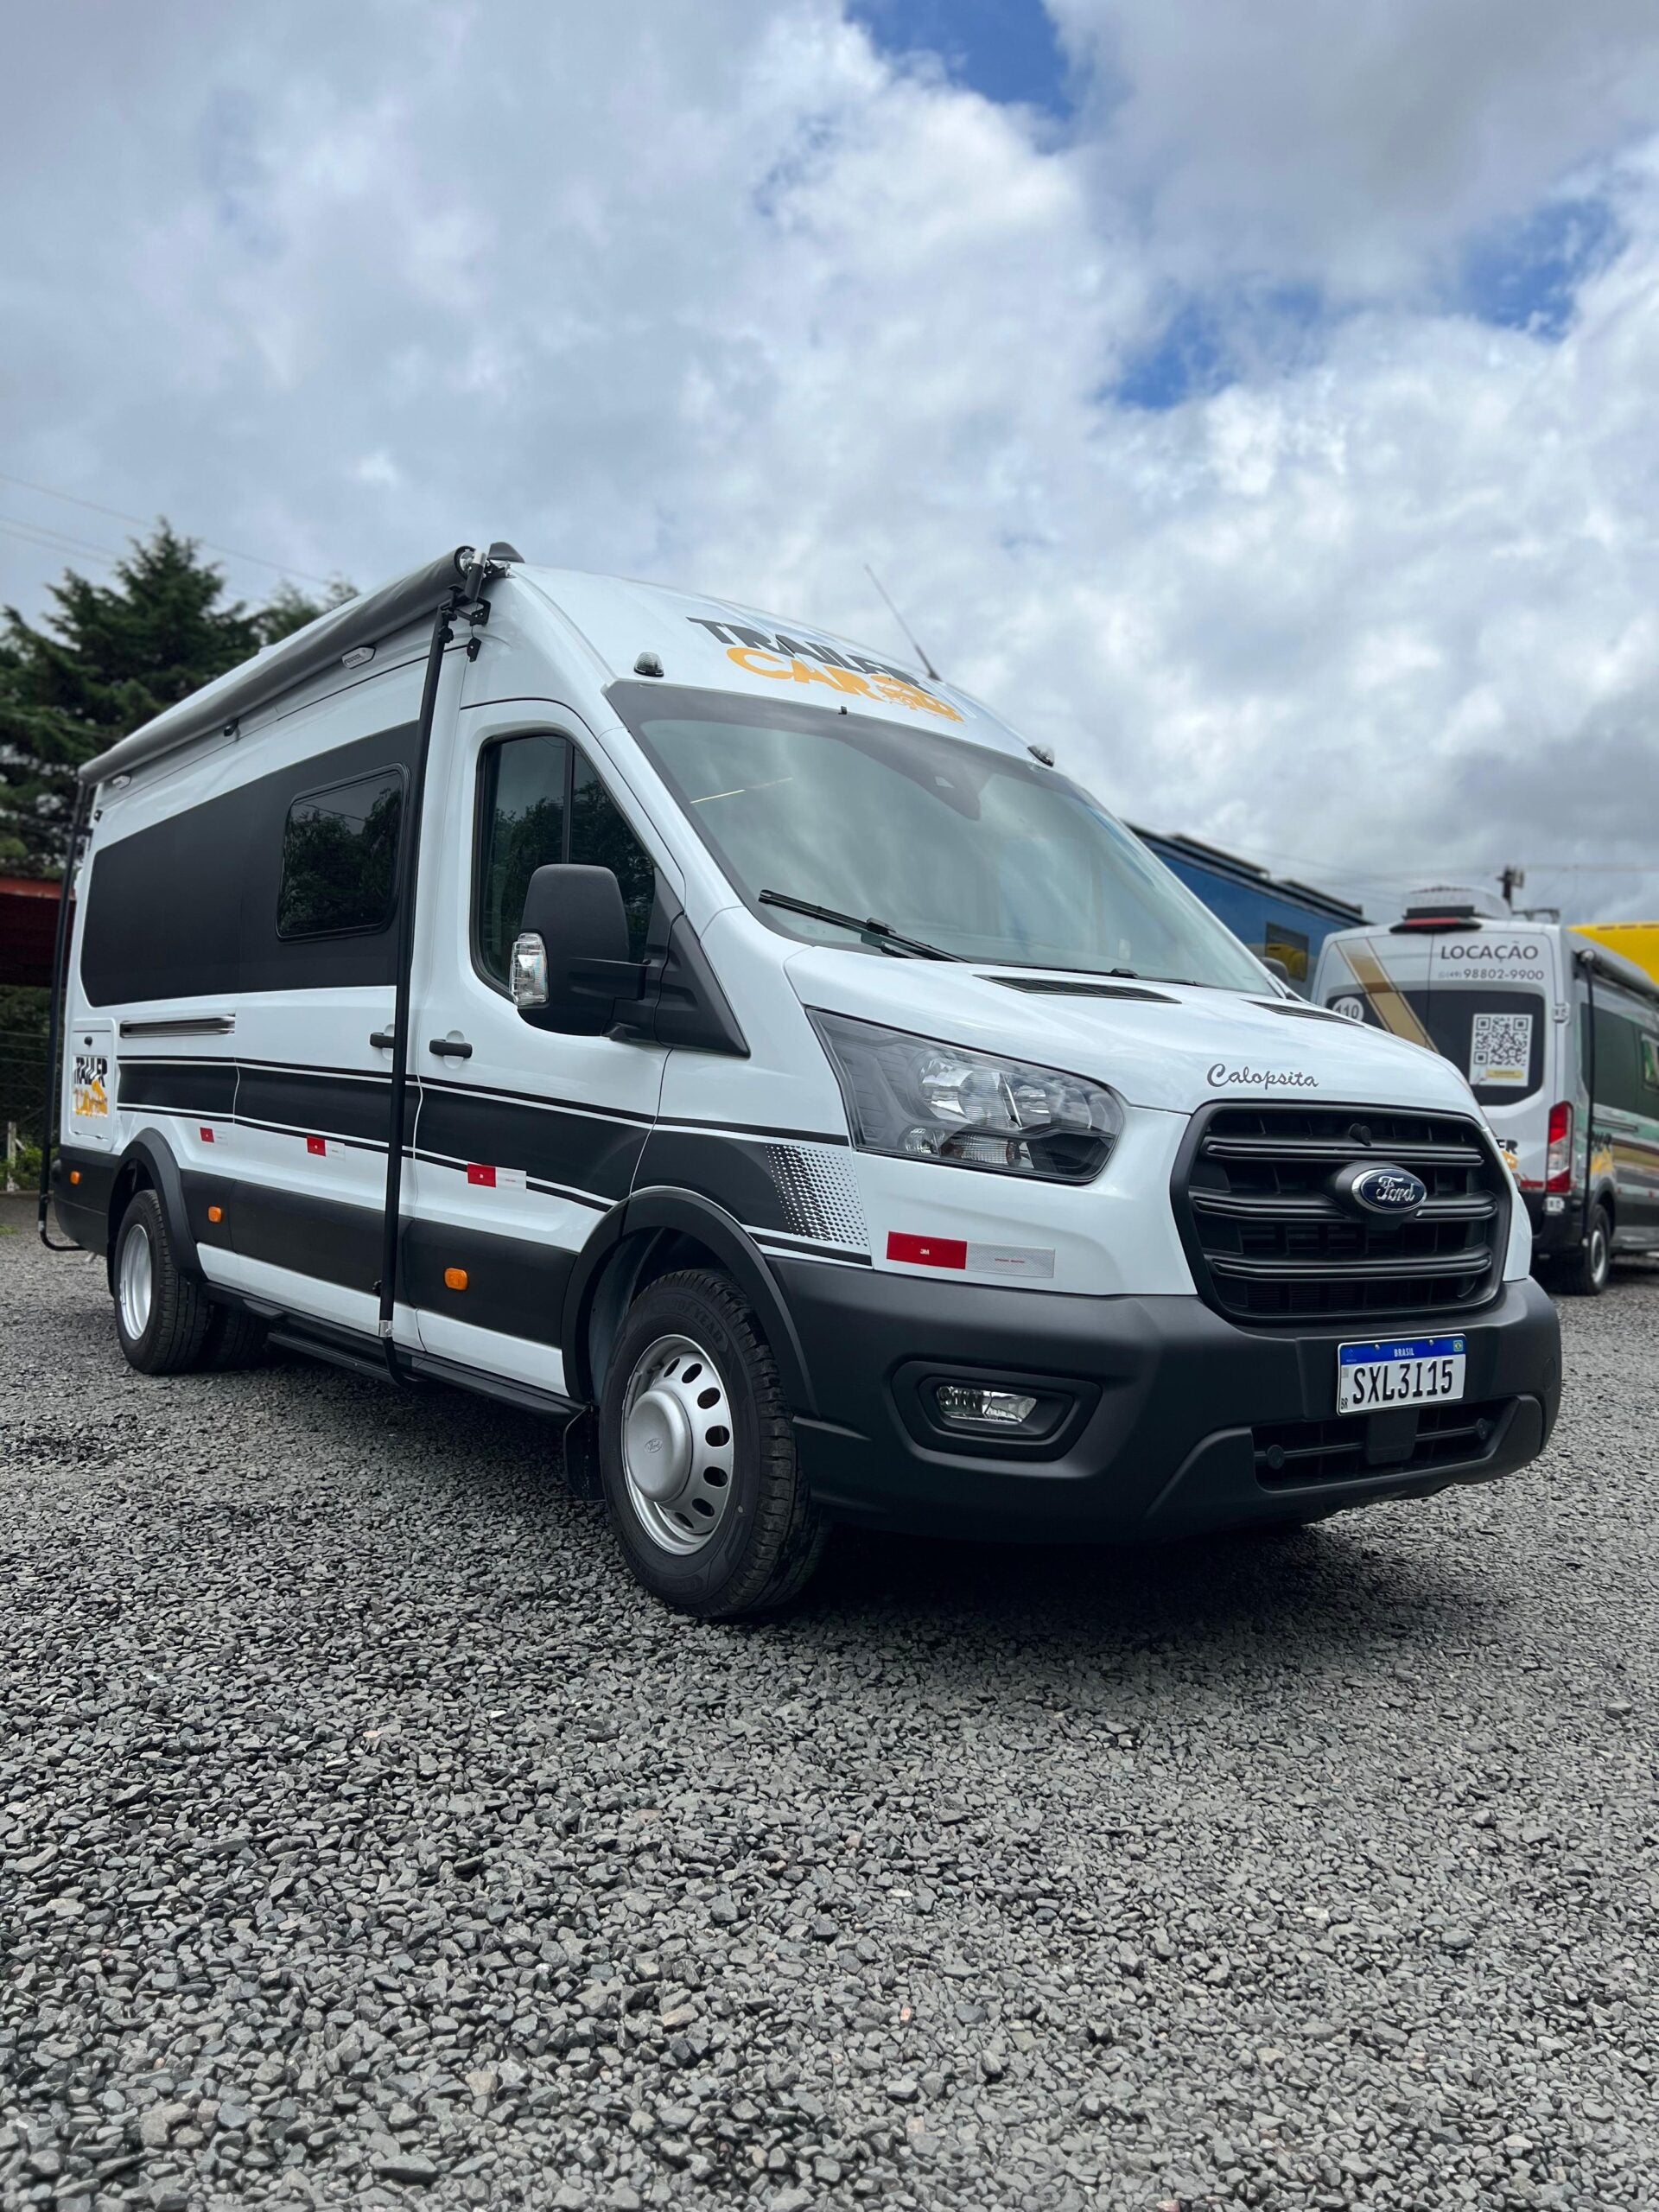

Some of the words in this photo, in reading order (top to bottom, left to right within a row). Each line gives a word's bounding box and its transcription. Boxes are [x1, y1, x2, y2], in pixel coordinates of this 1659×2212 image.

[686, 616, 937, 696] TRAILER
[1440, 940, 1539, 963] LOCAÇÃO
[1463, 968, 1544, 981] 98802-9900
[1207, 1063, 1319, 1090] Calopsita
[1376, 1175, 1415, 1202] Ford
[1394, 1347, 1414, 1357] BRASIL
[1352, 1358, 1454, 1405] SXL3I15
